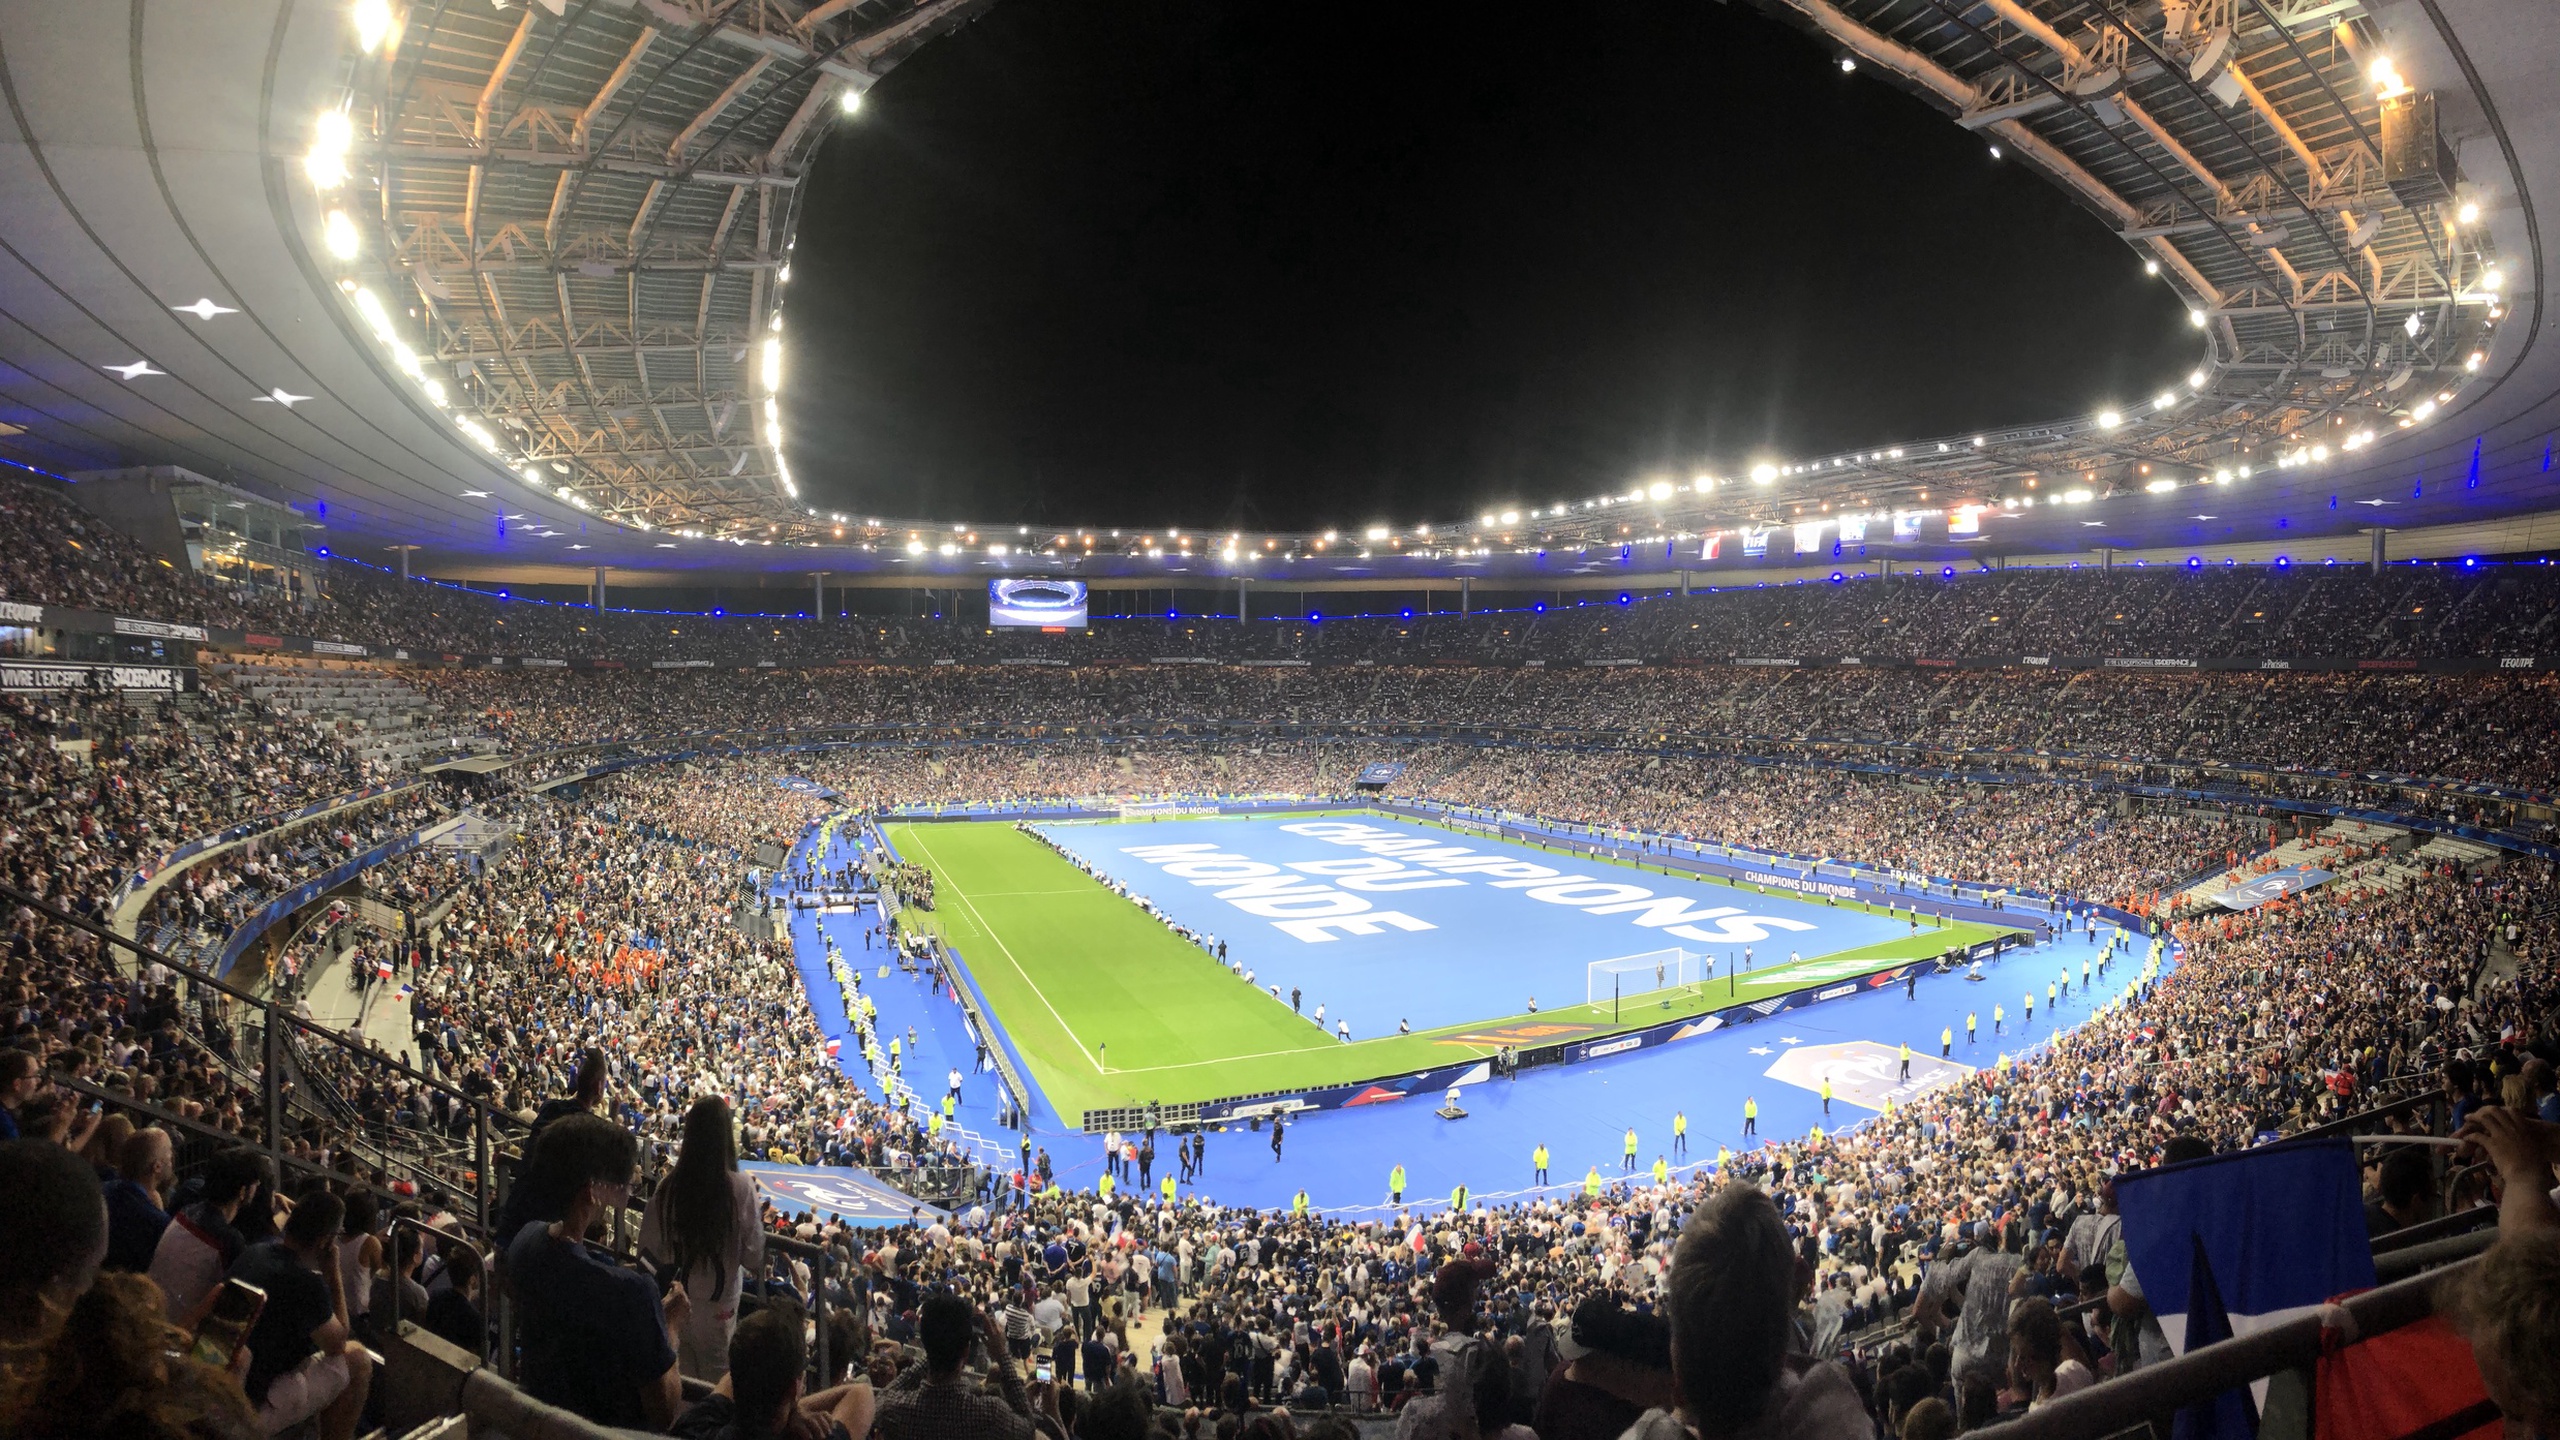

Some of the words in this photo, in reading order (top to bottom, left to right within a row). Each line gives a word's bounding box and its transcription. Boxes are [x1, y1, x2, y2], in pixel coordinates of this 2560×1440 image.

[1189, 806, 1220, 815] MONDE
[1279, 822, 1818, 943] CHAMPIONS
[1282, 857, 1470, 892] DU
[1745, 871, 1801, 891] CHAMPIONS
[1802, 880, 1817, 893] DU
[1818, 884, 1857, 899] MONDE
[1119, 843, 1439, 943] MONDE
[1878, 1068, 1950, 1101] FRANCE
